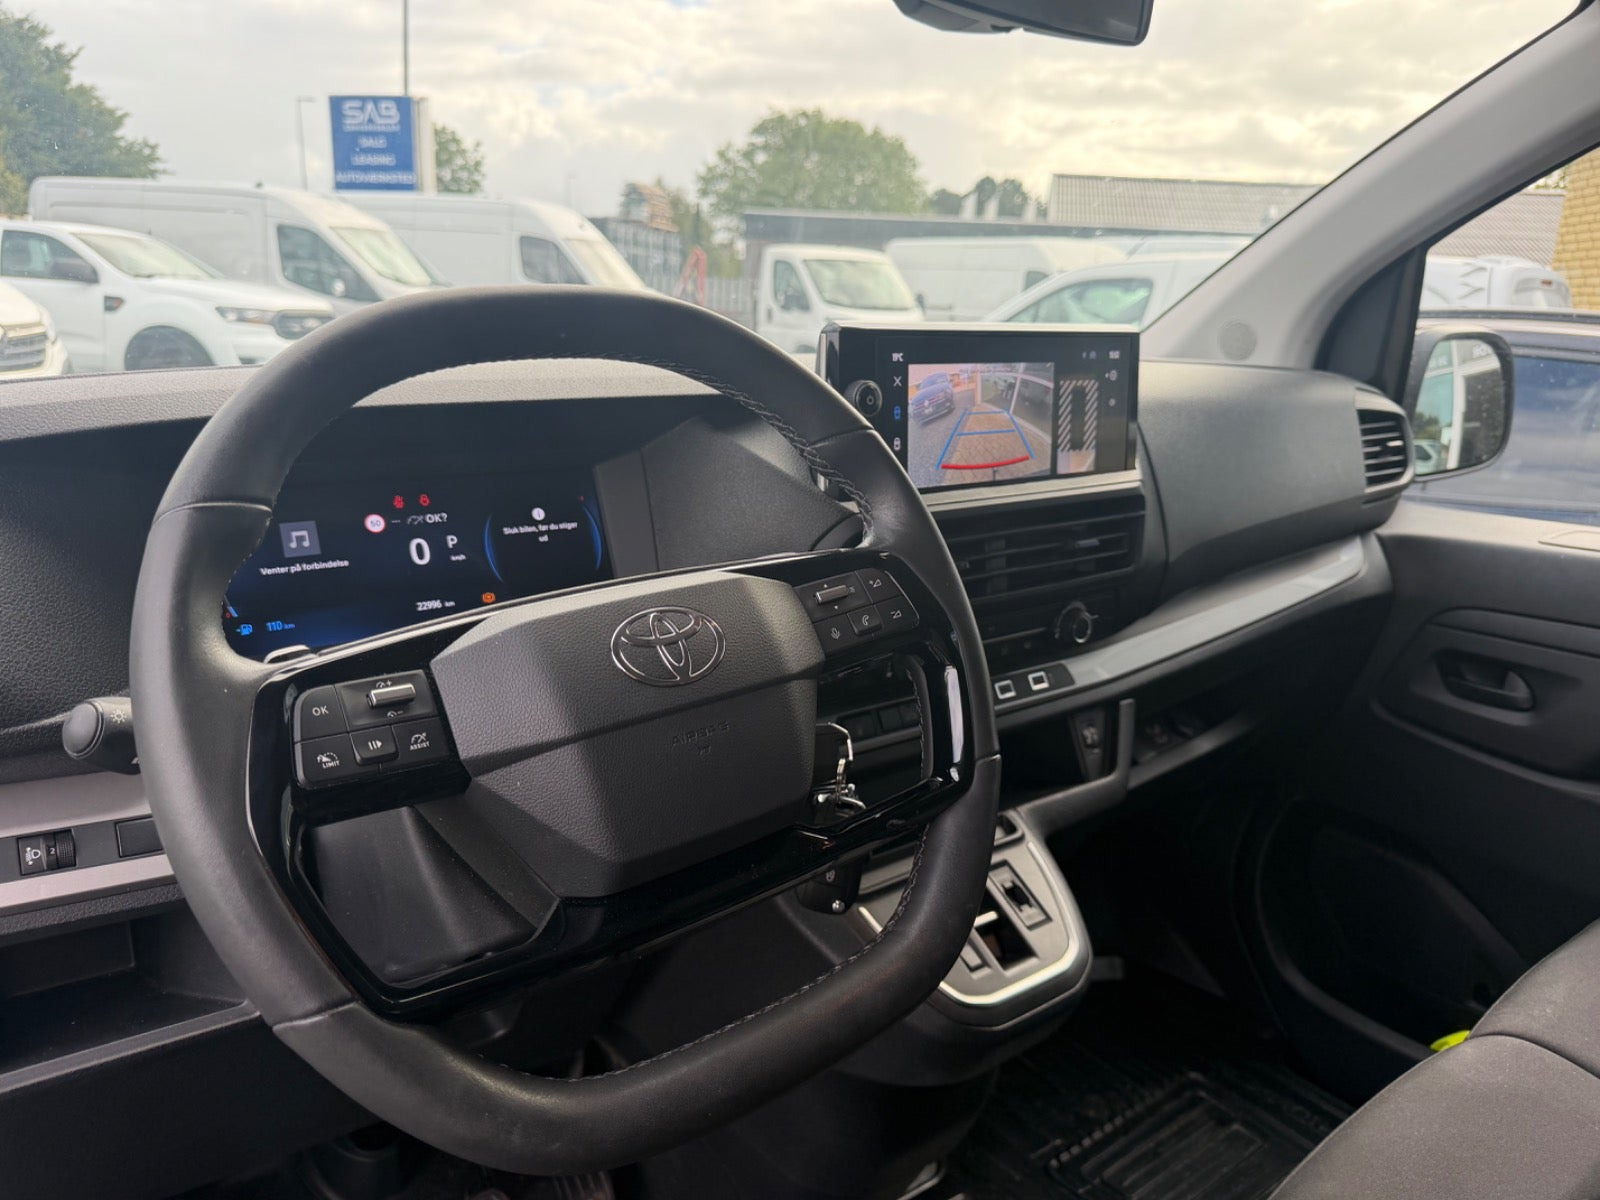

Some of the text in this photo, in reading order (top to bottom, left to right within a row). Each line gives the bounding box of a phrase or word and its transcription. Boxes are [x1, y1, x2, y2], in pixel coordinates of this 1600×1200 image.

[425, 512, 448, 523] OK?
[446, 535, 458, 548] P
[409, 537, 431, 565] 0
[259, 559, 350, 576] Venter på forbindelse
[266, 621, 283, 632] 110
[312, 706, 329, 716] OK
[322, 760, 340, 769] LIMIT
